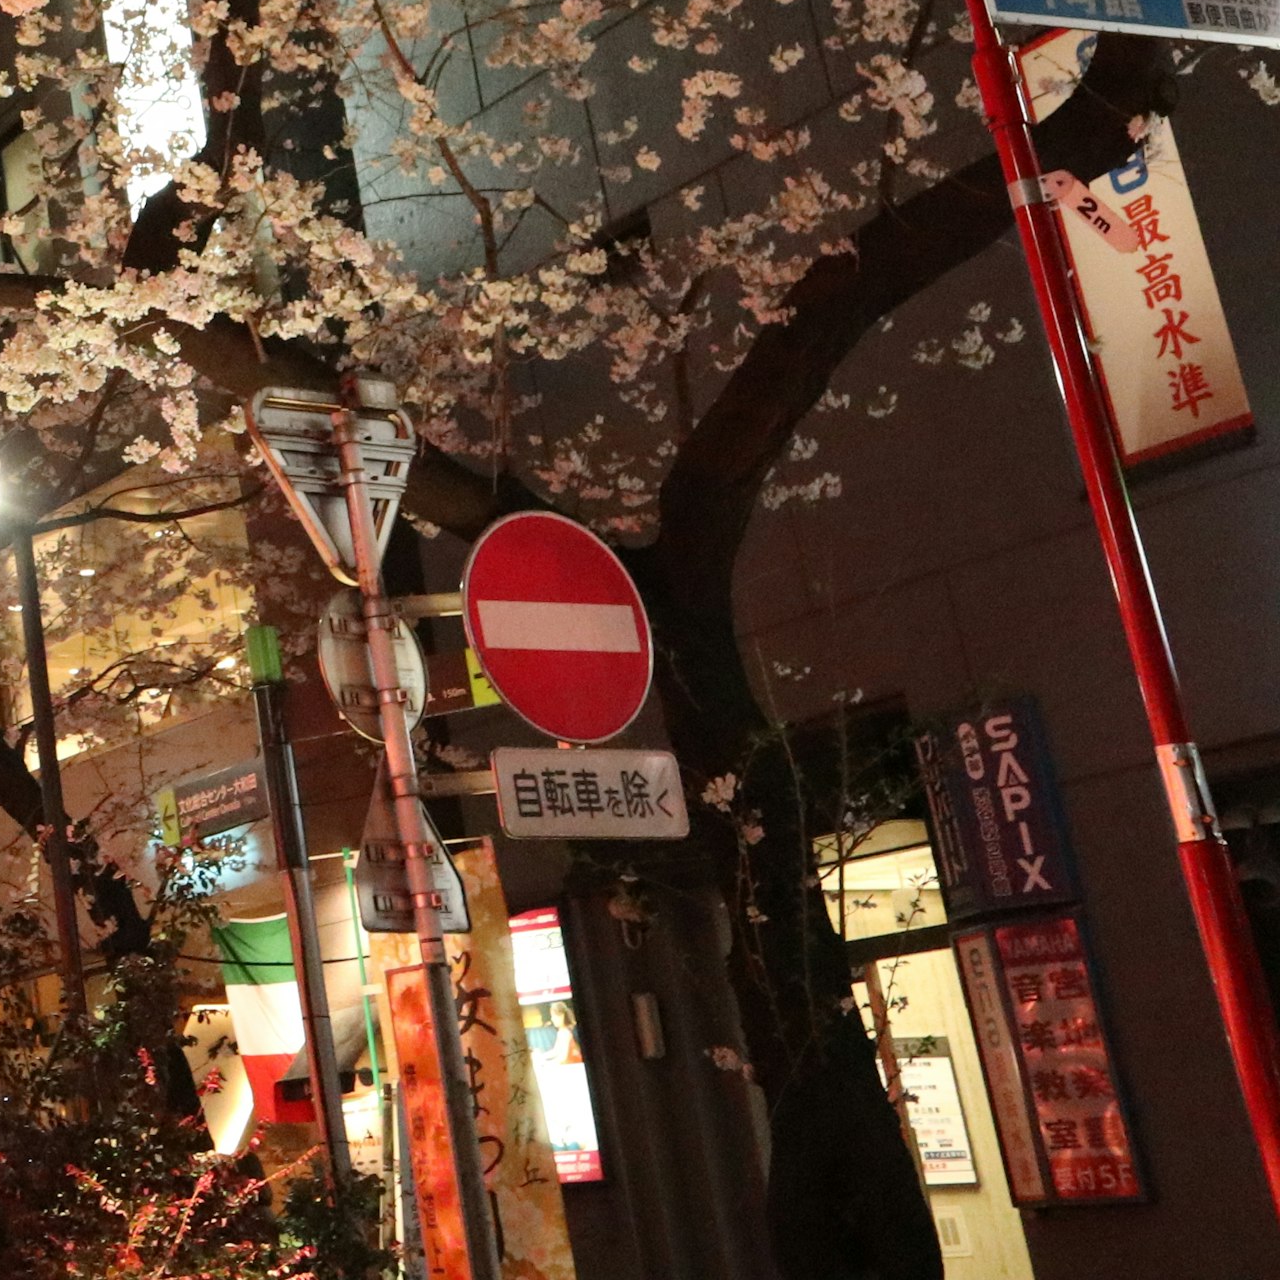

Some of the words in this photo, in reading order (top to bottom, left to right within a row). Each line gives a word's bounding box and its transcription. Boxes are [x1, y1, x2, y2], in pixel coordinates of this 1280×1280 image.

[1122, 194, 1214, 419] 最高水準
[513, 768, 674, 819] 自転車を除く
[985, 715, 1052, 893] SAPIX
[1005, 931, 1074, 958] YAMAHA
